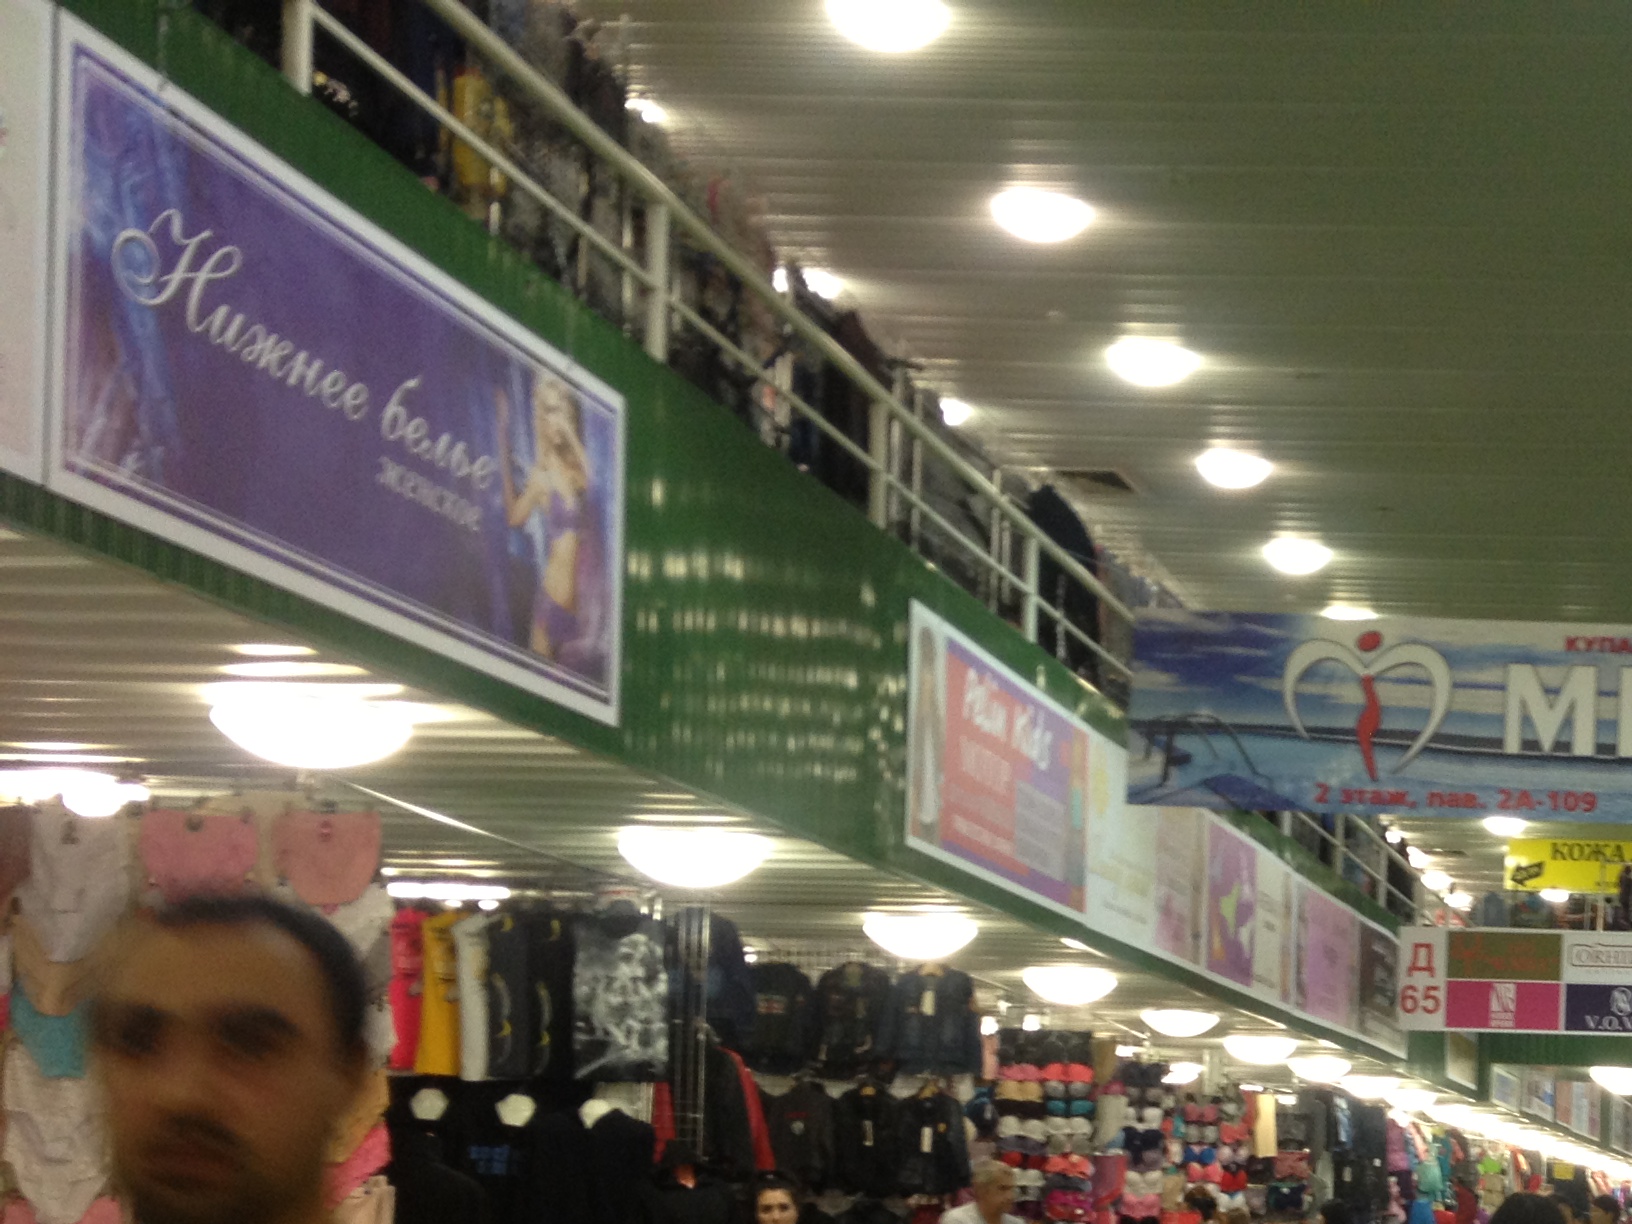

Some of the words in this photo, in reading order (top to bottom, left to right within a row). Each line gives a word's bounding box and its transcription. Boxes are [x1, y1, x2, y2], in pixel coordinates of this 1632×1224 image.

[111, 208, 369, 420] Нижнее
[380, 375, 499, 489] белье
[1314, 782, 1331, 804] 2
[1341, 788, 1417, 808] этаж,
[1426, 791, 1487, 810] пав.
[1550, 842, 1626, 863] КОЖА
[1407, 942, 1436, 977] Д
[1400, 984, 1441, 1014] 65
